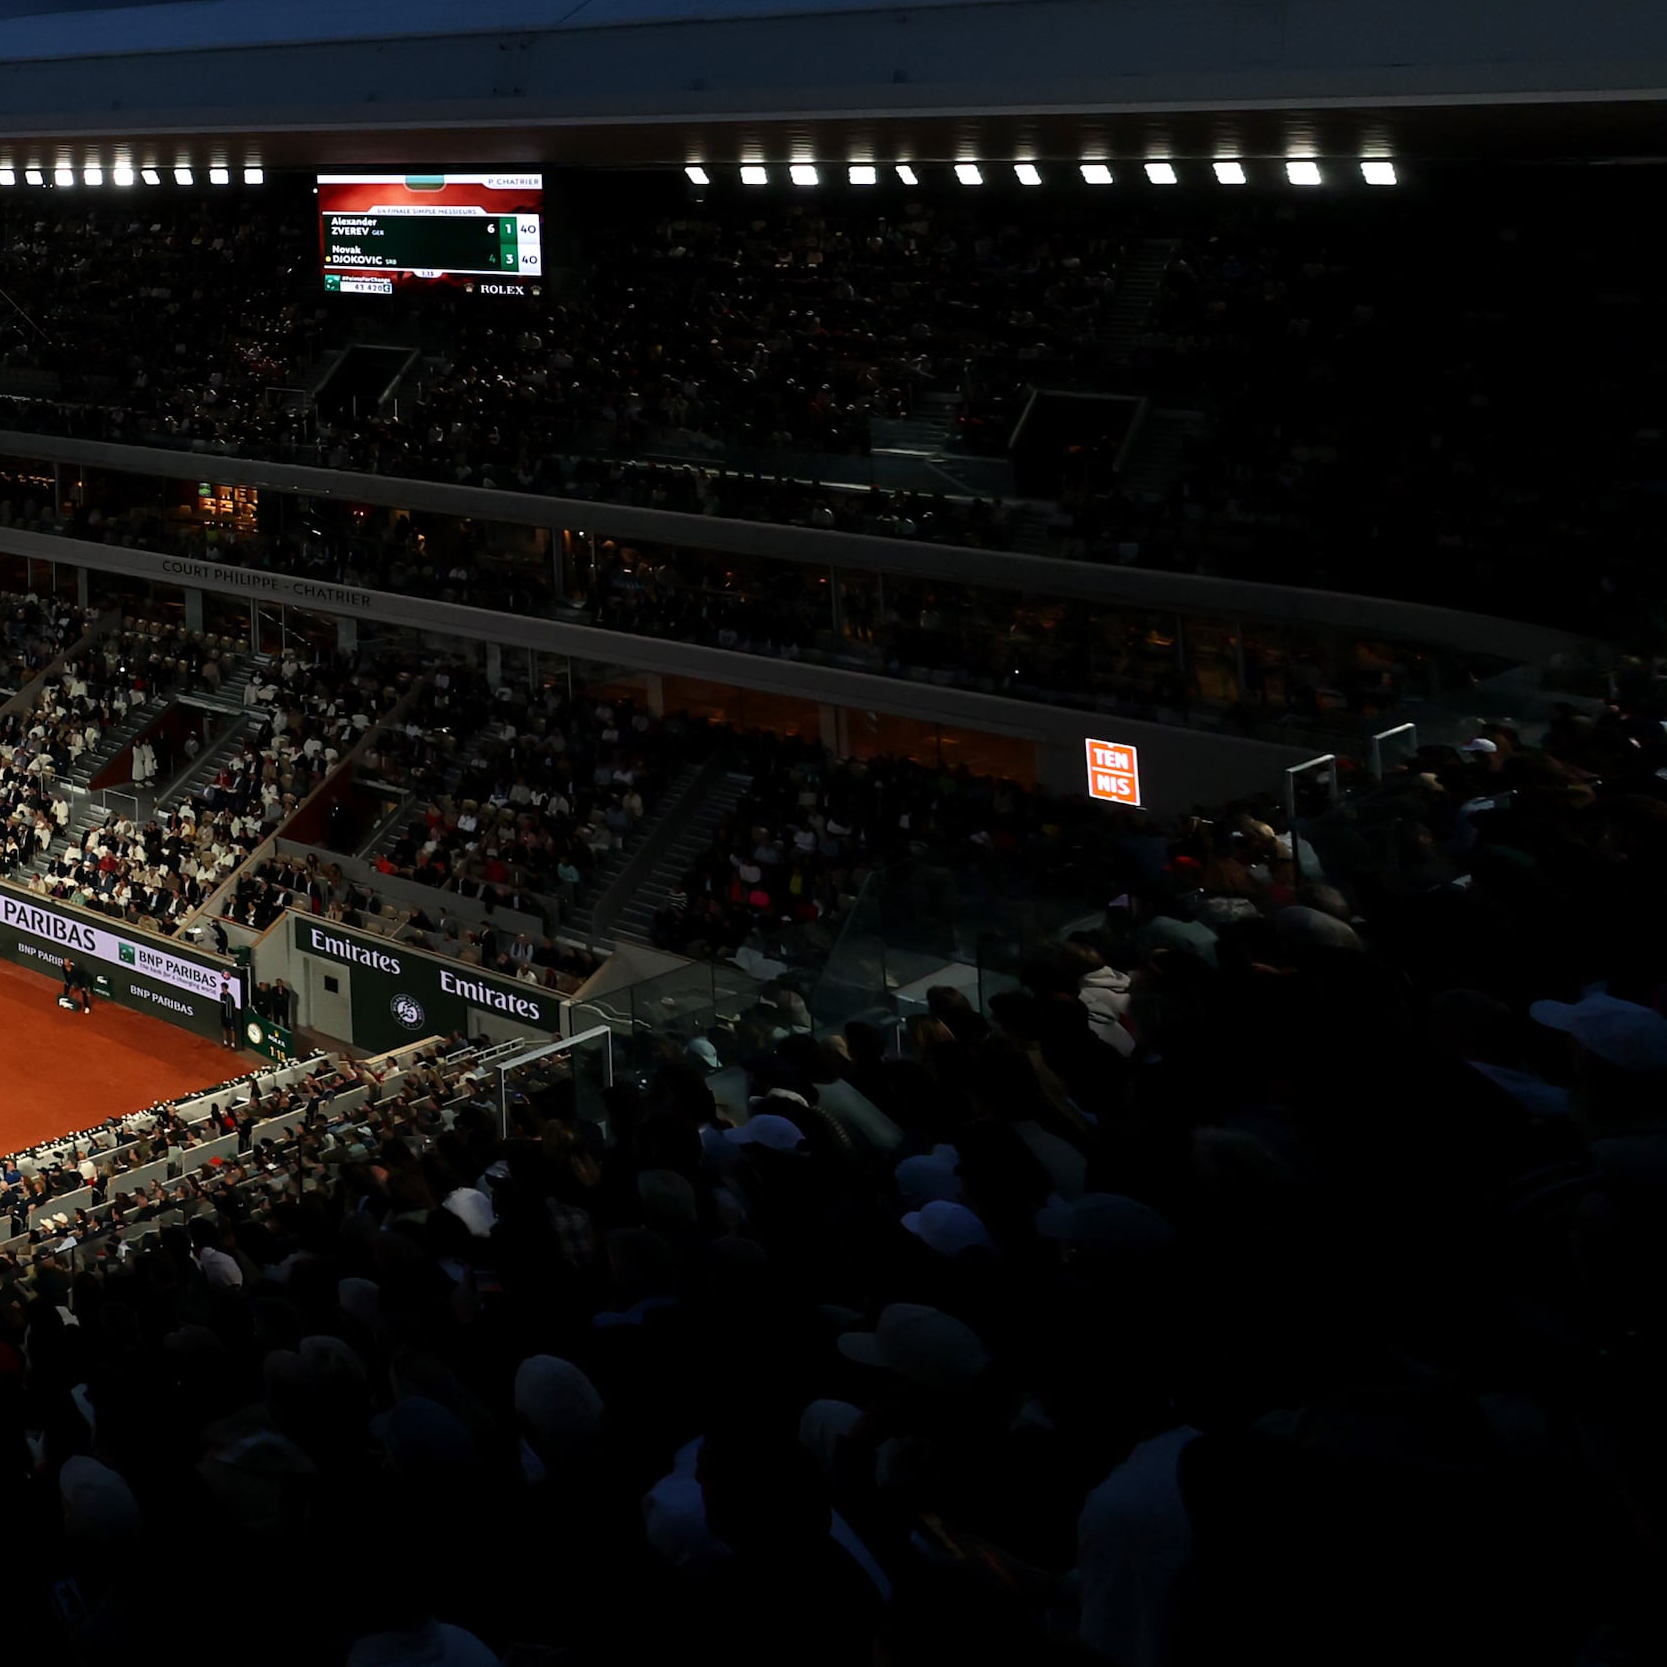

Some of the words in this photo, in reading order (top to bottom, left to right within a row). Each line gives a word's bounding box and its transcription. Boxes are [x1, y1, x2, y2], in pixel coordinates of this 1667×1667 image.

[331, 217, 377, 226] Alexander
[331, 227, 369, 235] ZVEREV
[487, 224, 495, 234] 6
[505, 224, 512, 234] 1
[520, 225, 537, 234] 40
[332, 245, 361, 254] Novak
[332, 255, 383, 265] DJOKOVIC
[489, 254, 496, 263] 4
[506, 254, 514, 264] 3
[521, 255, 538, 264] 40
[480, 284, 525, 295] ROLEX
[162, 560, 209, 579] COURT
[214, 569, 279, 591] PHILIPPE
[293, 584, 371, 607] CHATRIER
[1093, 747, 1129, 770] TEN
[1097, 774, 1131, 796] NIS
[4, 900, 96, 951] PARIBAS
[18, 942, 37, 956] BNP
[139, 951, 163, 967] BNP
[166, 960, 217, 988] PARIBAS
[311, 928, 401, 975] Emirates
[440, 970, 540, 1020] Emirates
[130, 984, 150, 999] BNP
[152, 993, 194, 1016] PARIBAS
